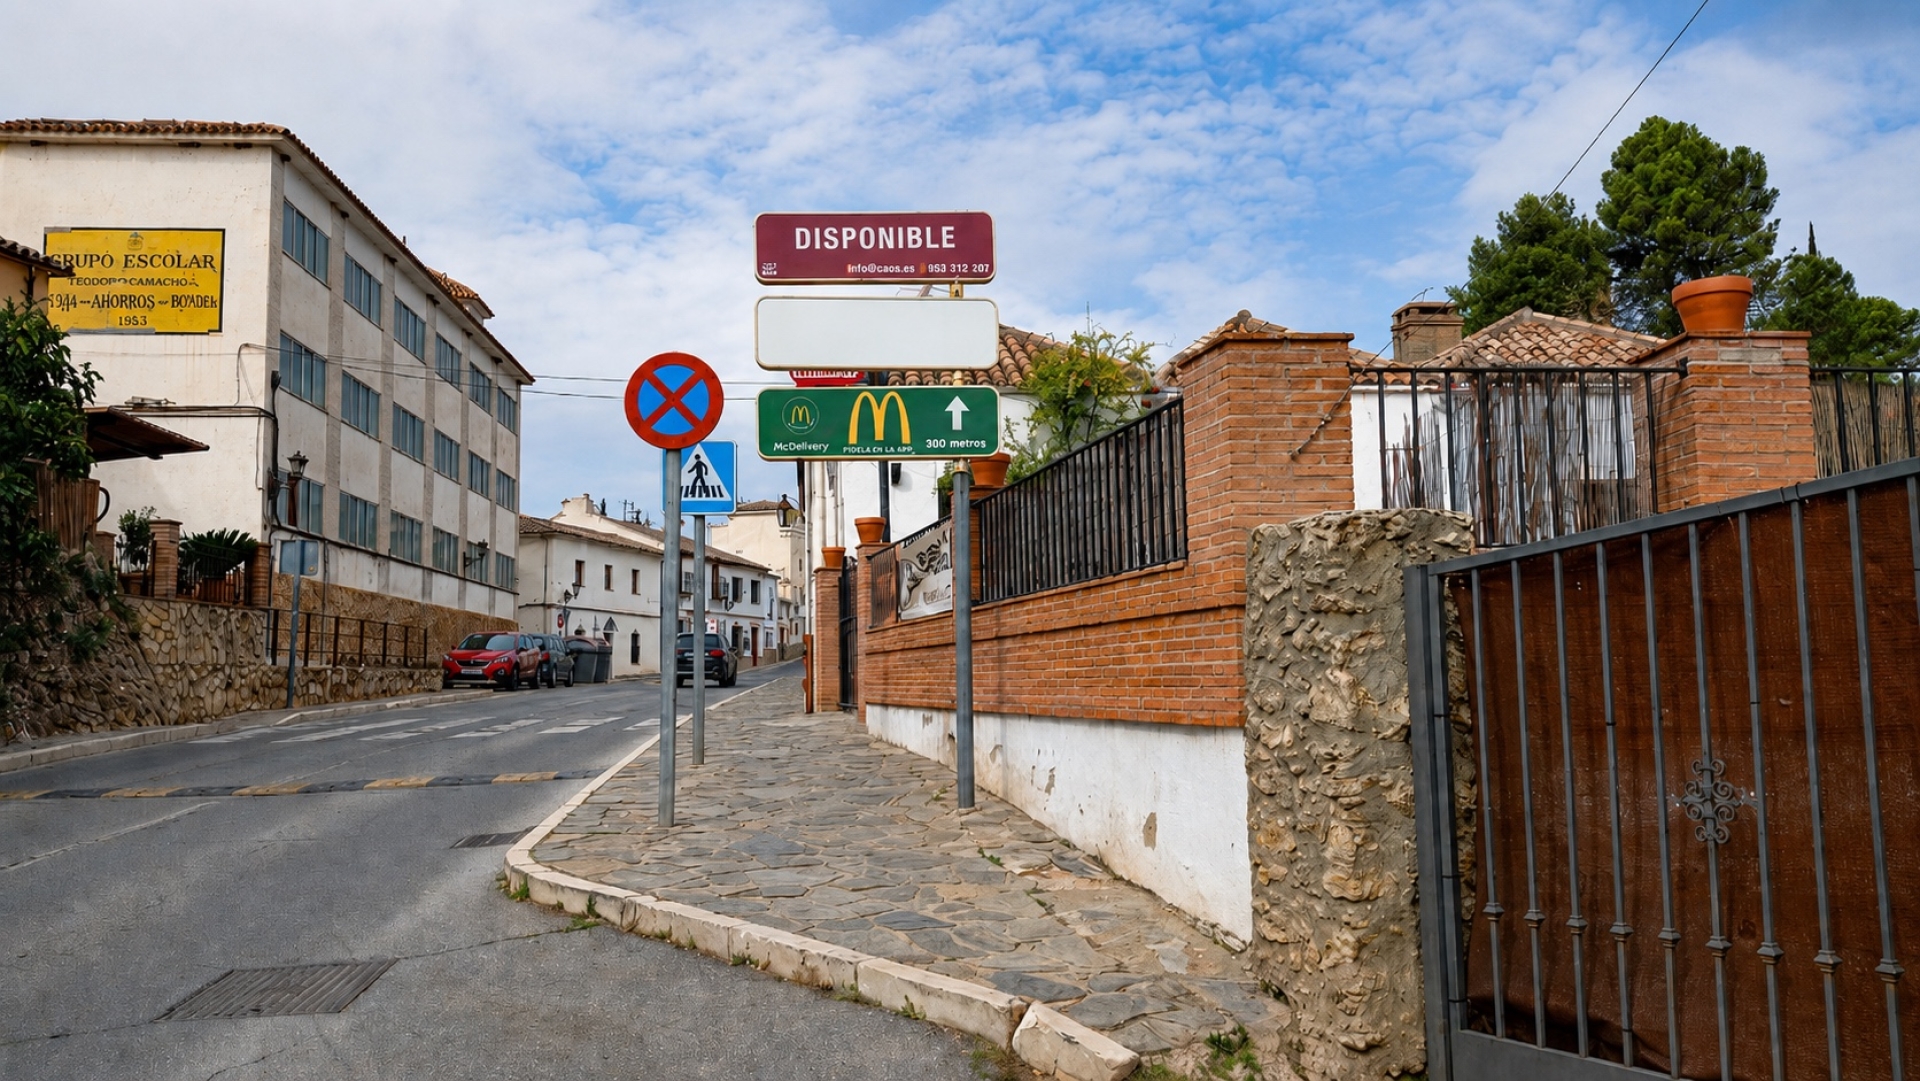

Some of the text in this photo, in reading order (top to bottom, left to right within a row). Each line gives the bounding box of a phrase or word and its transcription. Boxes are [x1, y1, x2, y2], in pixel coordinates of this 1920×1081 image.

[795, 226, 956, 250] DISPONIBLE
[51, 253, 217, 270] GRUPO ESCOLAR
[928, 263, 947, 273] 953
[950, 263, 969, 273] 312
[972, 263, 990, 273] 207
[129, 277, 188, 287] CAMACHO
[91, 293, 155, 310] AHORROS
[773, 441, 830, 453] McDelivery
[926, 439, 987, 449] 300 metros
